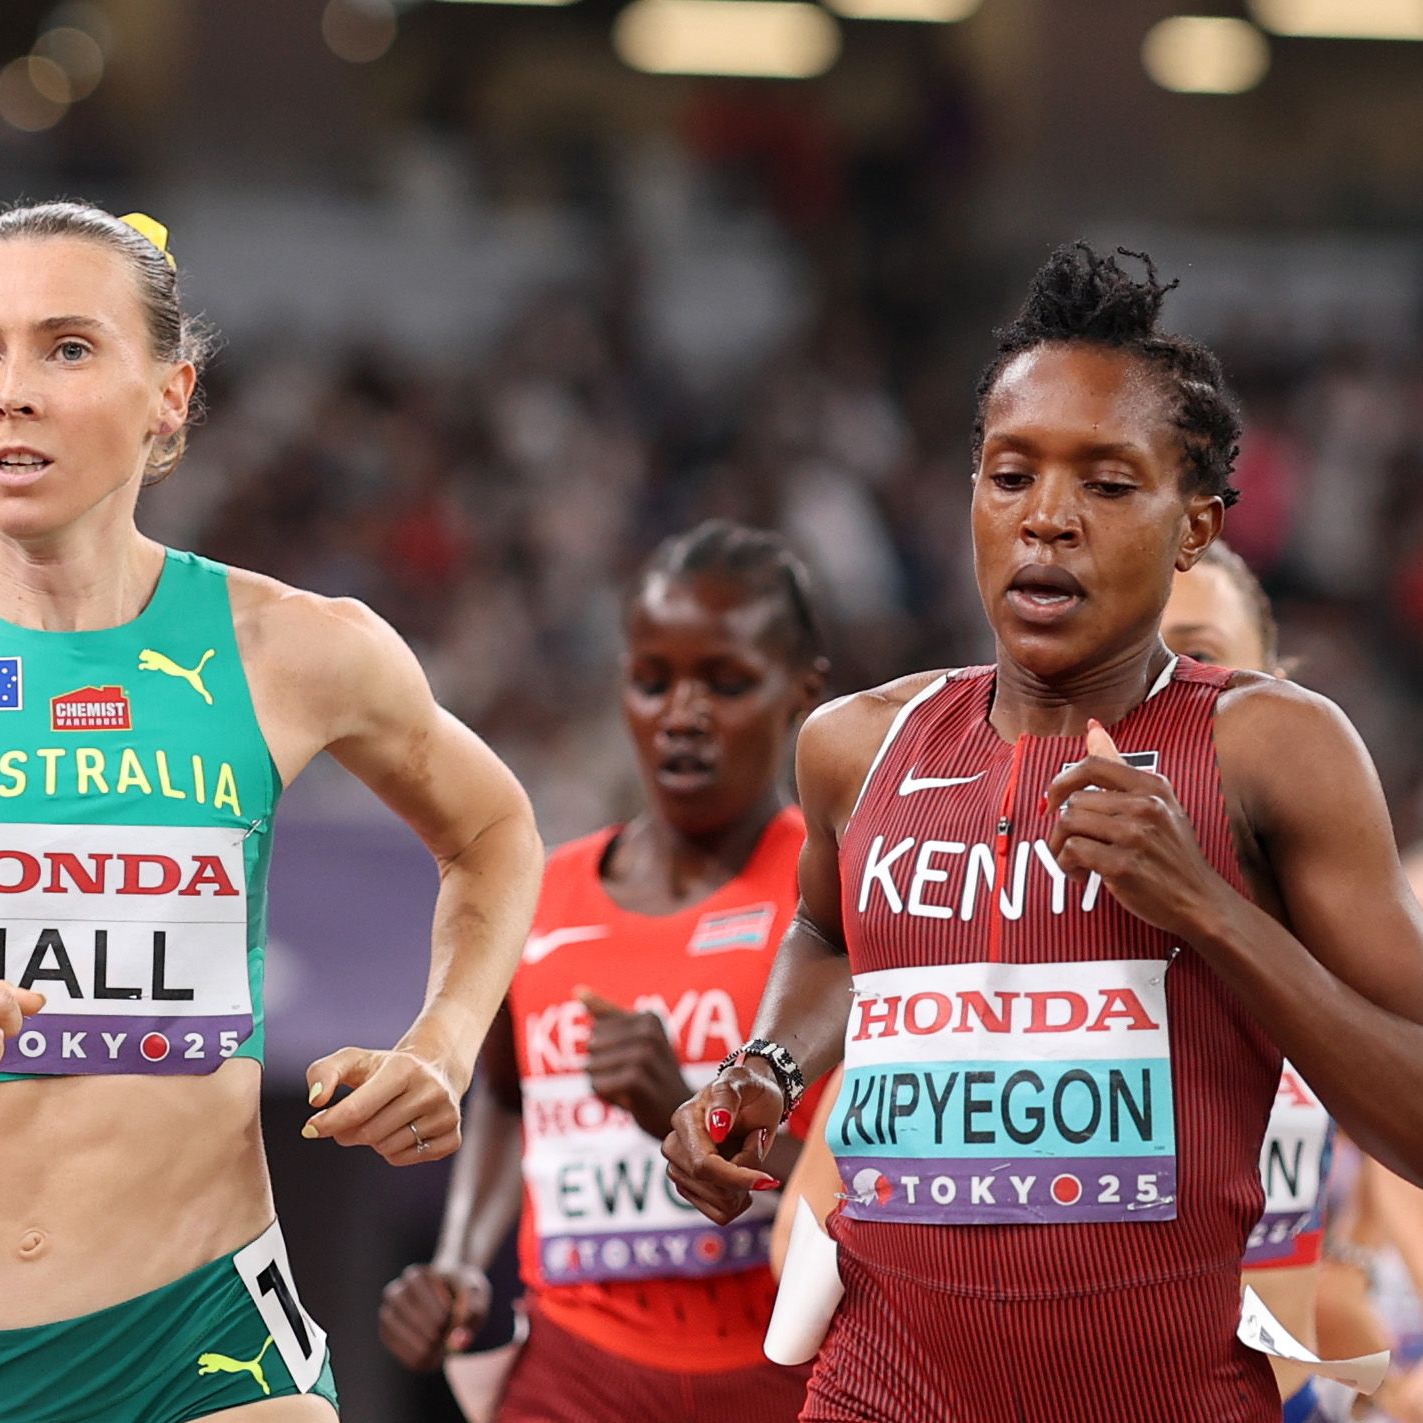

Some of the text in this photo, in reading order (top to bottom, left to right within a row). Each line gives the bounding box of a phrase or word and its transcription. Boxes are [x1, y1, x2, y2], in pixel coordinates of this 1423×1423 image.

[56, 702, 126, 717] CHEMIST
[56, 718, 125, 727] WAREHOUSE
[858, 835, 1103, 922] KENY
[527, 989, 745, 1078] KEYA
[851, 988, 1160, 1042] HONDA
[183, 1031, 239, 1059] 25
[841, 1069, 1154, 1146] KIPYEGON
[1097, 1174, 1158, 1203] 25
[256, 1259, 313, 1361] 1
